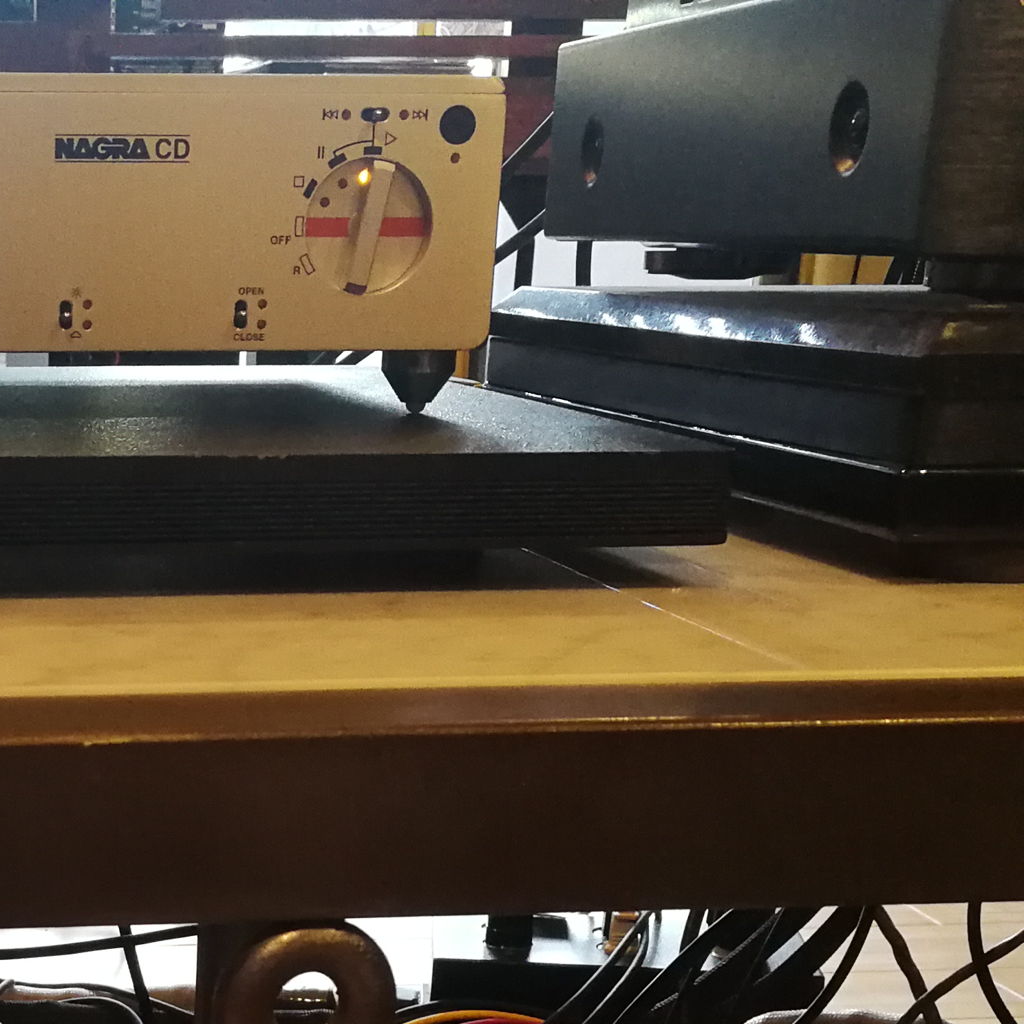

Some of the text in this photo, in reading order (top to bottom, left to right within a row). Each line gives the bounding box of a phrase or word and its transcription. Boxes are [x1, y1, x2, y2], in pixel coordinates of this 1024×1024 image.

[55, 137, 190, 160] NAGRA CD
[270, 235, 291, 245] OFF
[293, 265, 301, 275] R
[238, 287, 264, 296] OPEN
[233, 333, 265, 341] CLOSE
